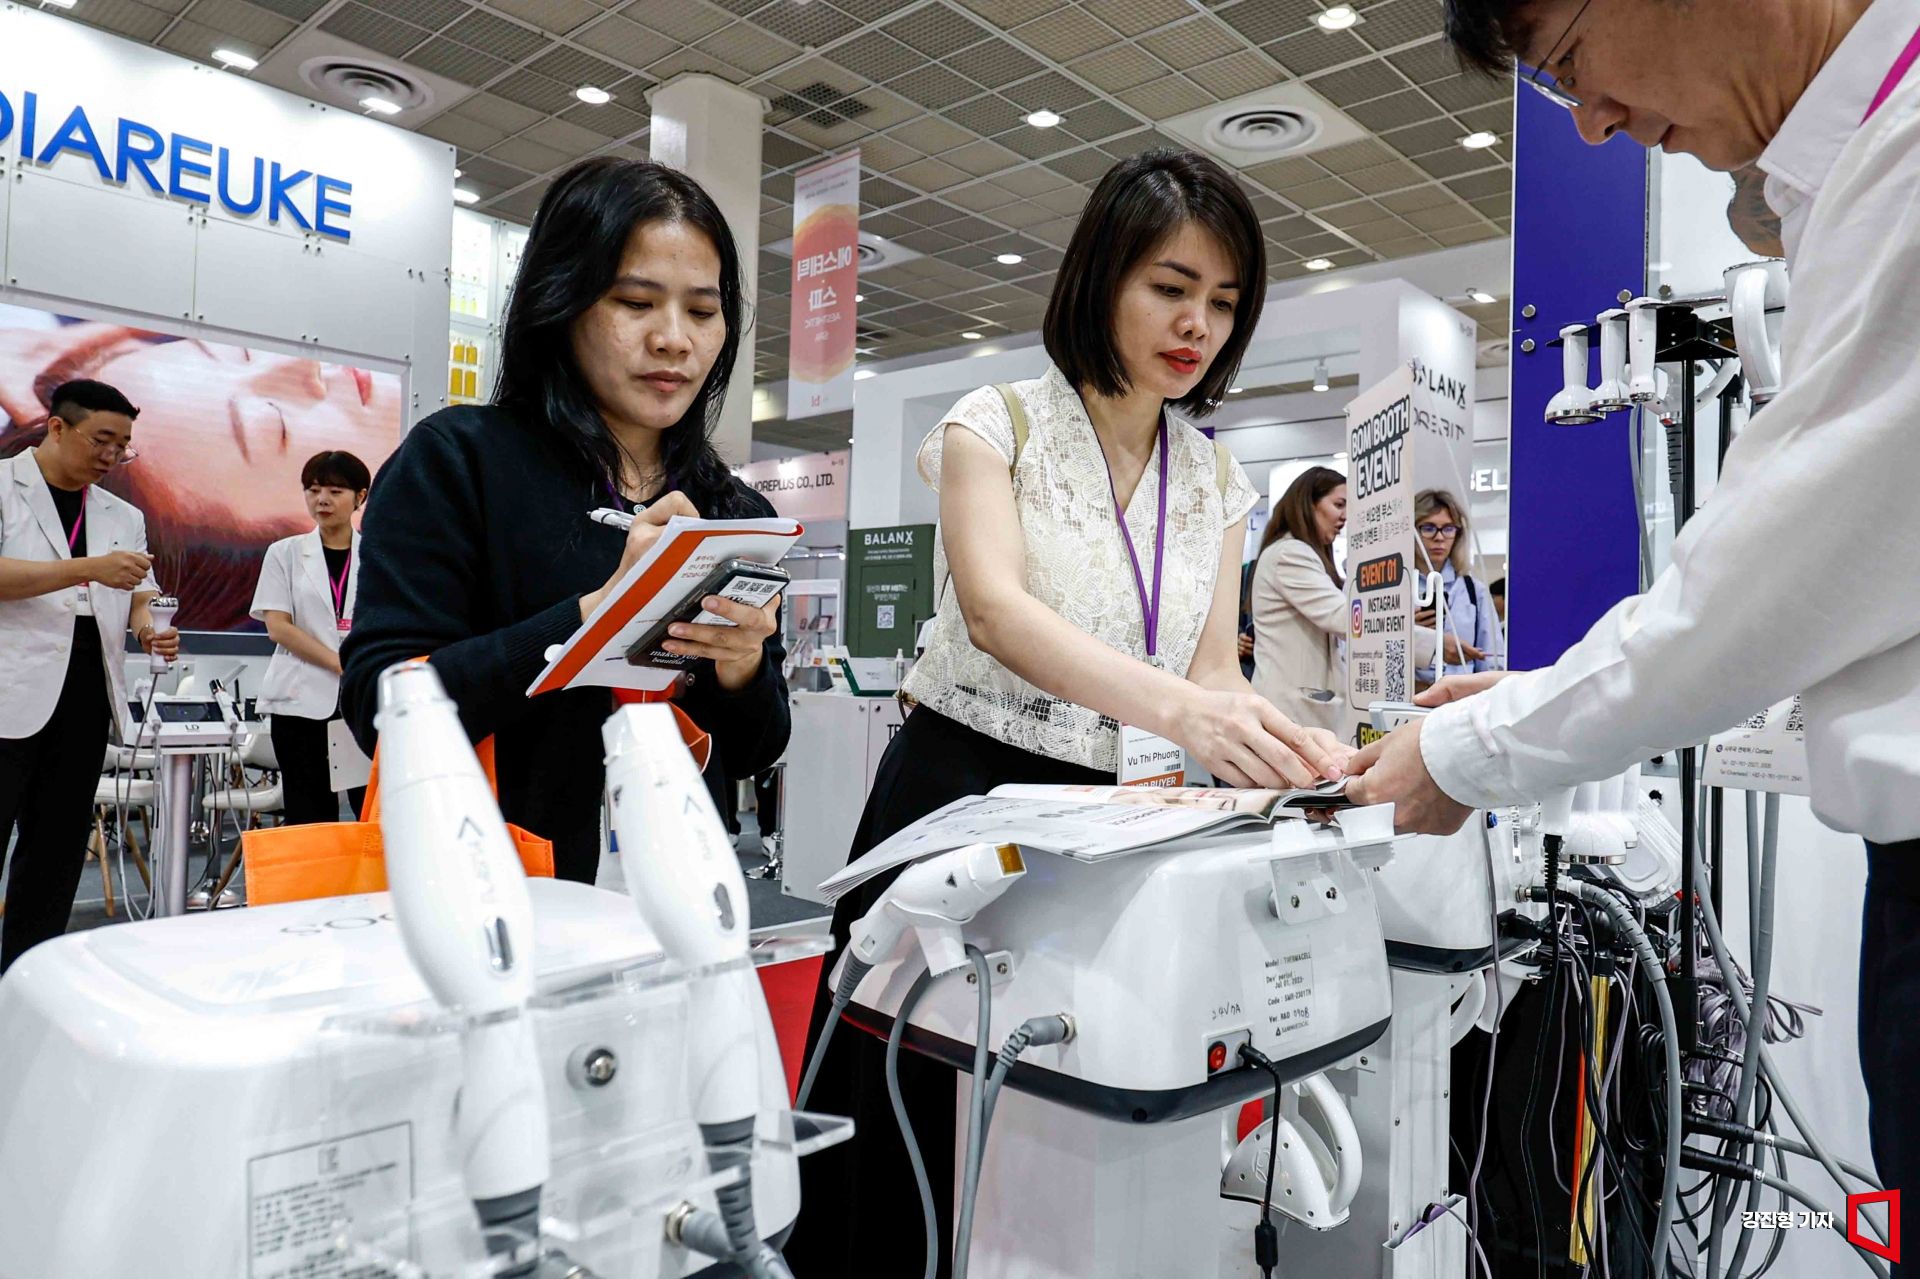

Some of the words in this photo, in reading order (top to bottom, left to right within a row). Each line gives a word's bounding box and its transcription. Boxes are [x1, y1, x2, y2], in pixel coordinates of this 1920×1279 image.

[1352, 422, 1372, 461] BOM
[1373, 397, 1410, 447] BOOTH
[1357, 437, 1403, 498] EVENT
[816, 472, 835, 487] LTD.
[864, 531, 914, 546] BALANX
[1361, 562, 1386, 588] EVENT
[1387, 558, 1398, 583] 01
[1367, 594, 1401, 613] INSTAGRAM
[1364, 617, 1385, 634] FOLLOW
[1386, 615, 1405, 633] EVENT
[1127, 756, 1138, 766] Vu
[1140, 753, 1151, 764] Thi
[1153, 749, 1180, 763] Phuong
